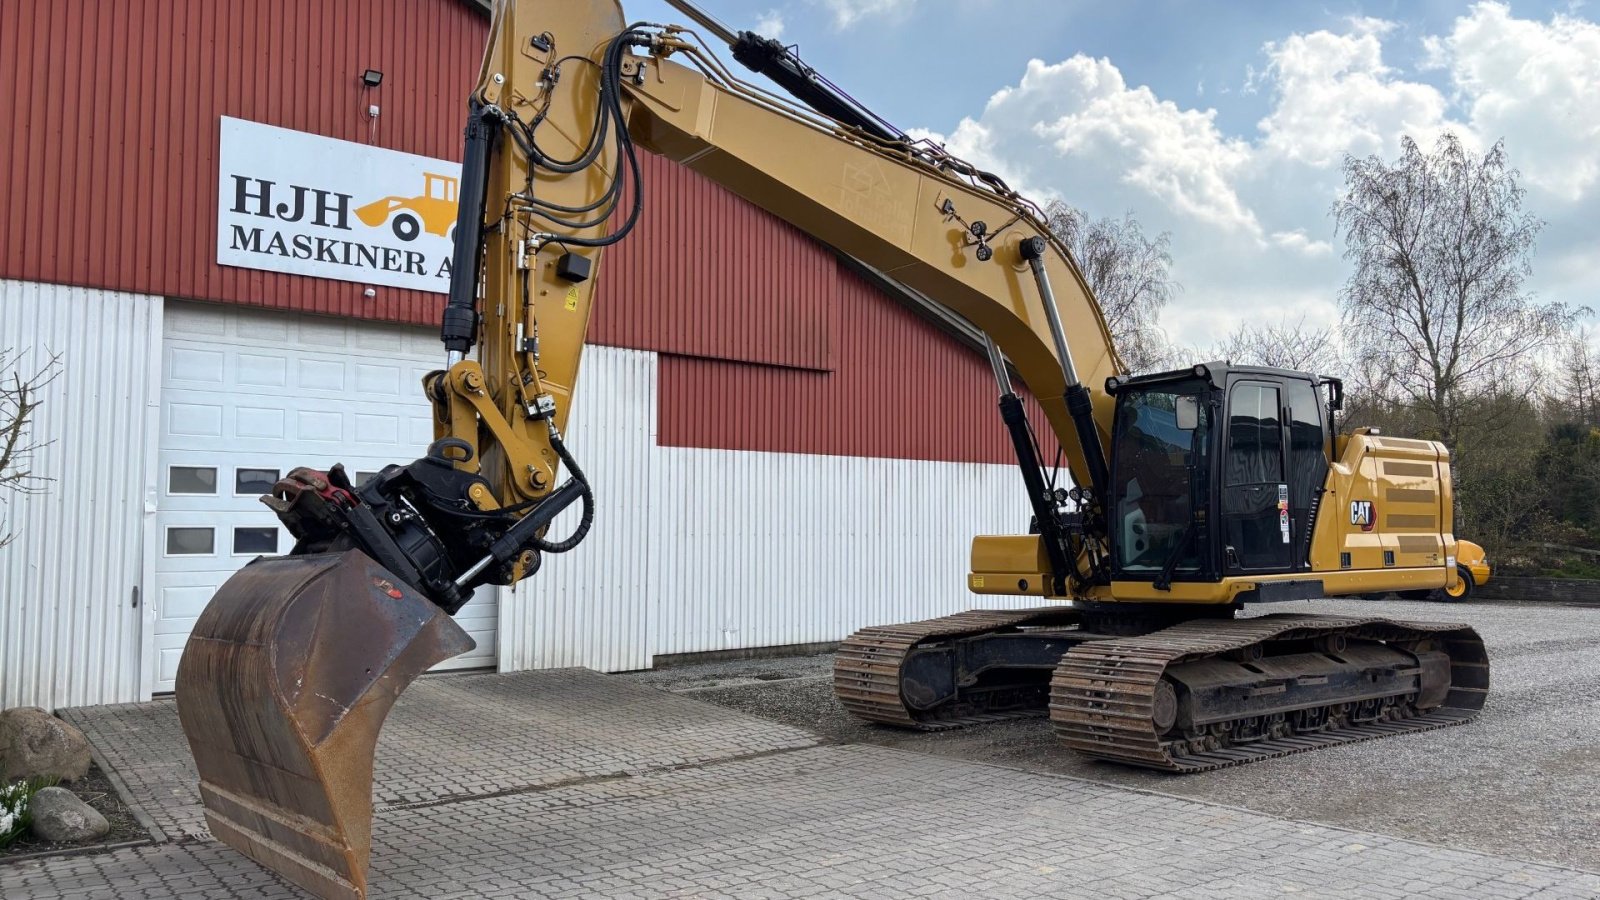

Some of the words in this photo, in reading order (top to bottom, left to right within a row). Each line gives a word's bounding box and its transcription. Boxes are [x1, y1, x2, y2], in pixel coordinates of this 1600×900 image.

[230, 174, 353, 230] HJH
[229, 224, 427, 276] MASKINER
[1350, 501, 1370, 525] CAT
